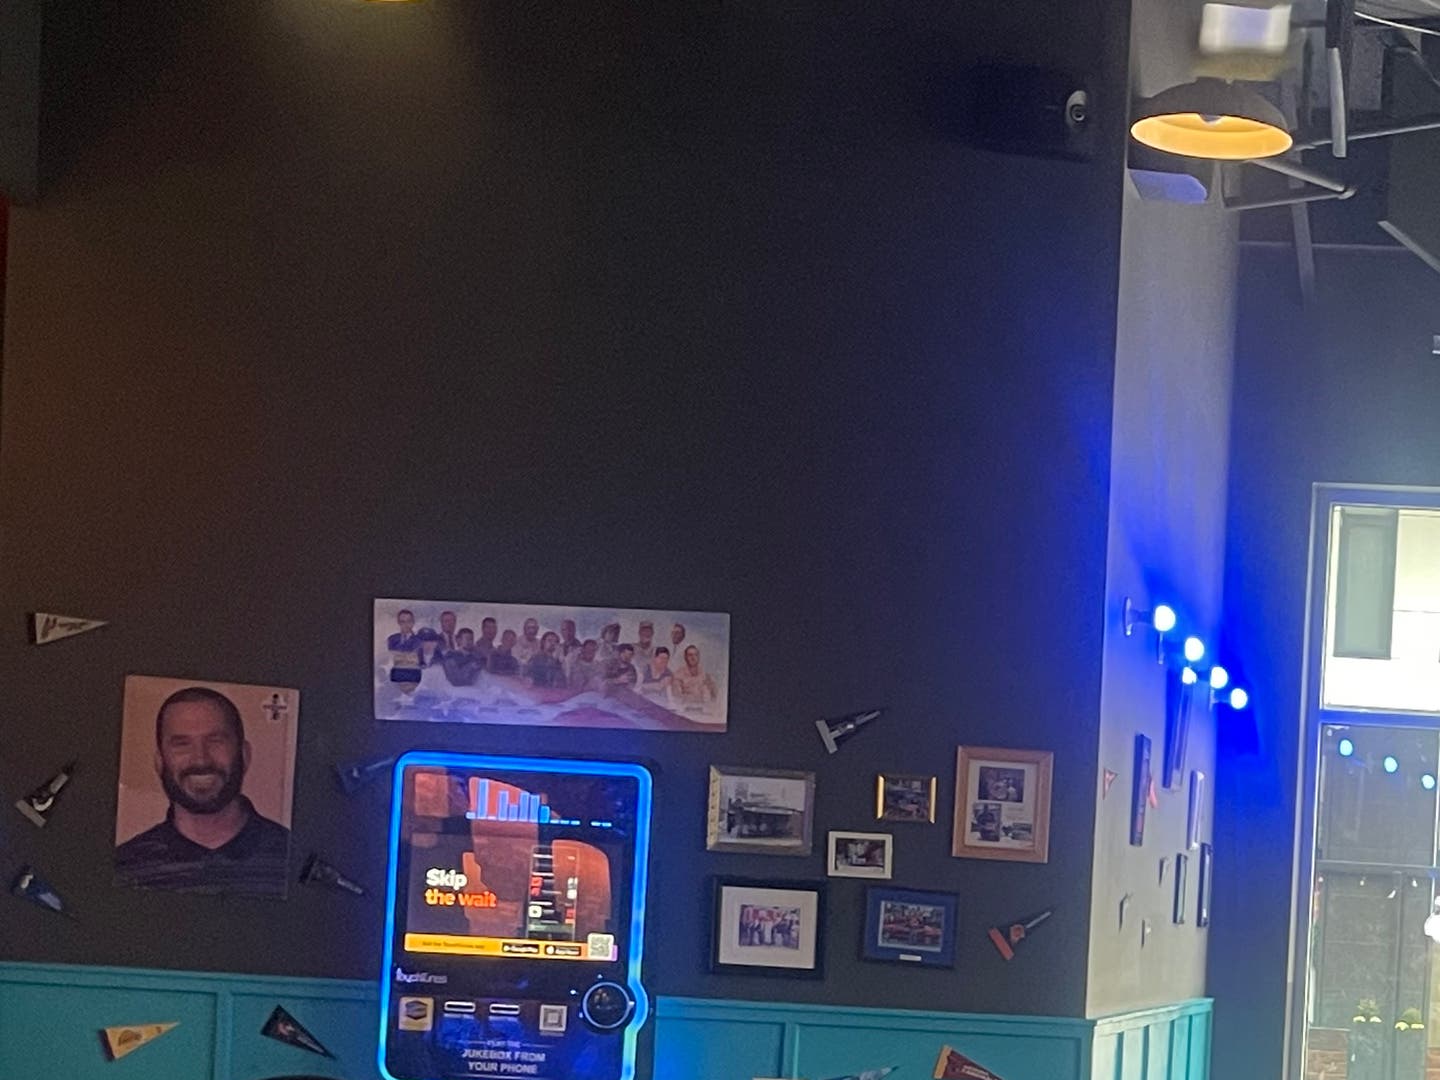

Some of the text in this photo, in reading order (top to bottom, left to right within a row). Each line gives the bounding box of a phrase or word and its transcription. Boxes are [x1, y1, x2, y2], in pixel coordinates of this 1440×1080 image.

[426, 867, 467, 890] Skip
[425, 889, 497, 908] the wait
[462, 1049, 546, 1062] JUKEBOX FROM
[468, 1062, 537, 1074] YOUR PHONE
